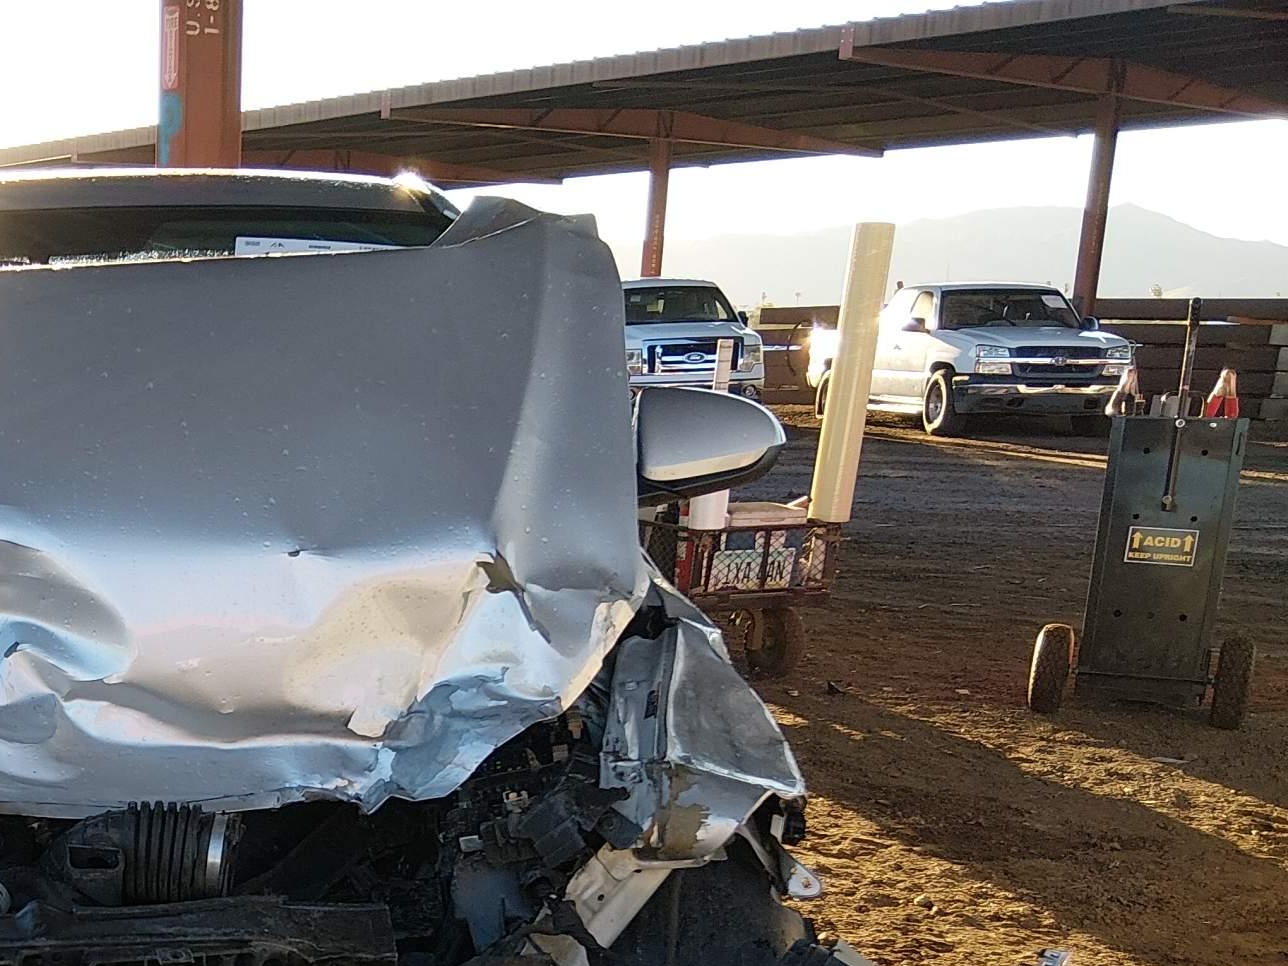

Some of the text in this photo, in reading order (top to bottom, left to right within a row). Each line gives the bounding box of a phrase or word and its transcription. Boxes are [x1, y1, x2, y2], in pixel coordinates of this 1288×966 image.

[1143, 535, 1182, 548] ACID
[1127, 551, 1193, 562] KEEP UPRIGHT
